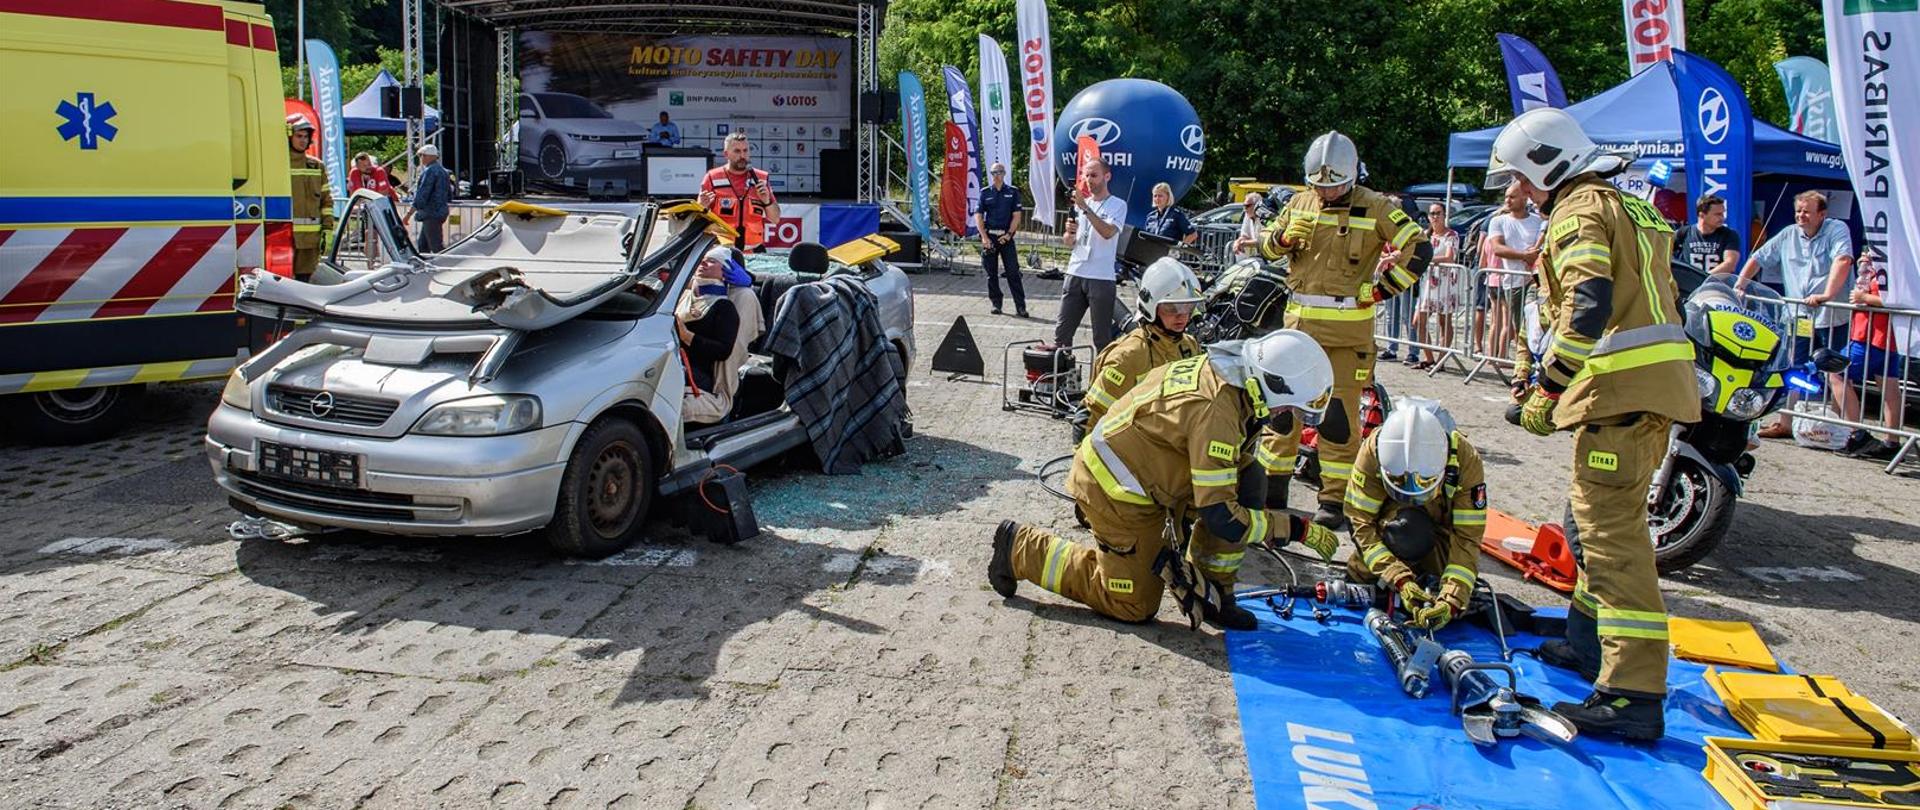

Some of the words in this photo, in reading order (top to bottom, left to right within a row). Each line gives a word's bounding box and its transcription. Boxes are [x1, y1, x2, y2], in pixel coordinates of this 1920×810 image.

[631, 46, 702, 66] MOTO
[706, 48, 792, 68] SAFETY
[794, 49, 843, 69] DAY
[786, 96, 817, 107] LOTOS
[1062, 152, 1132, 167] HYDAI
